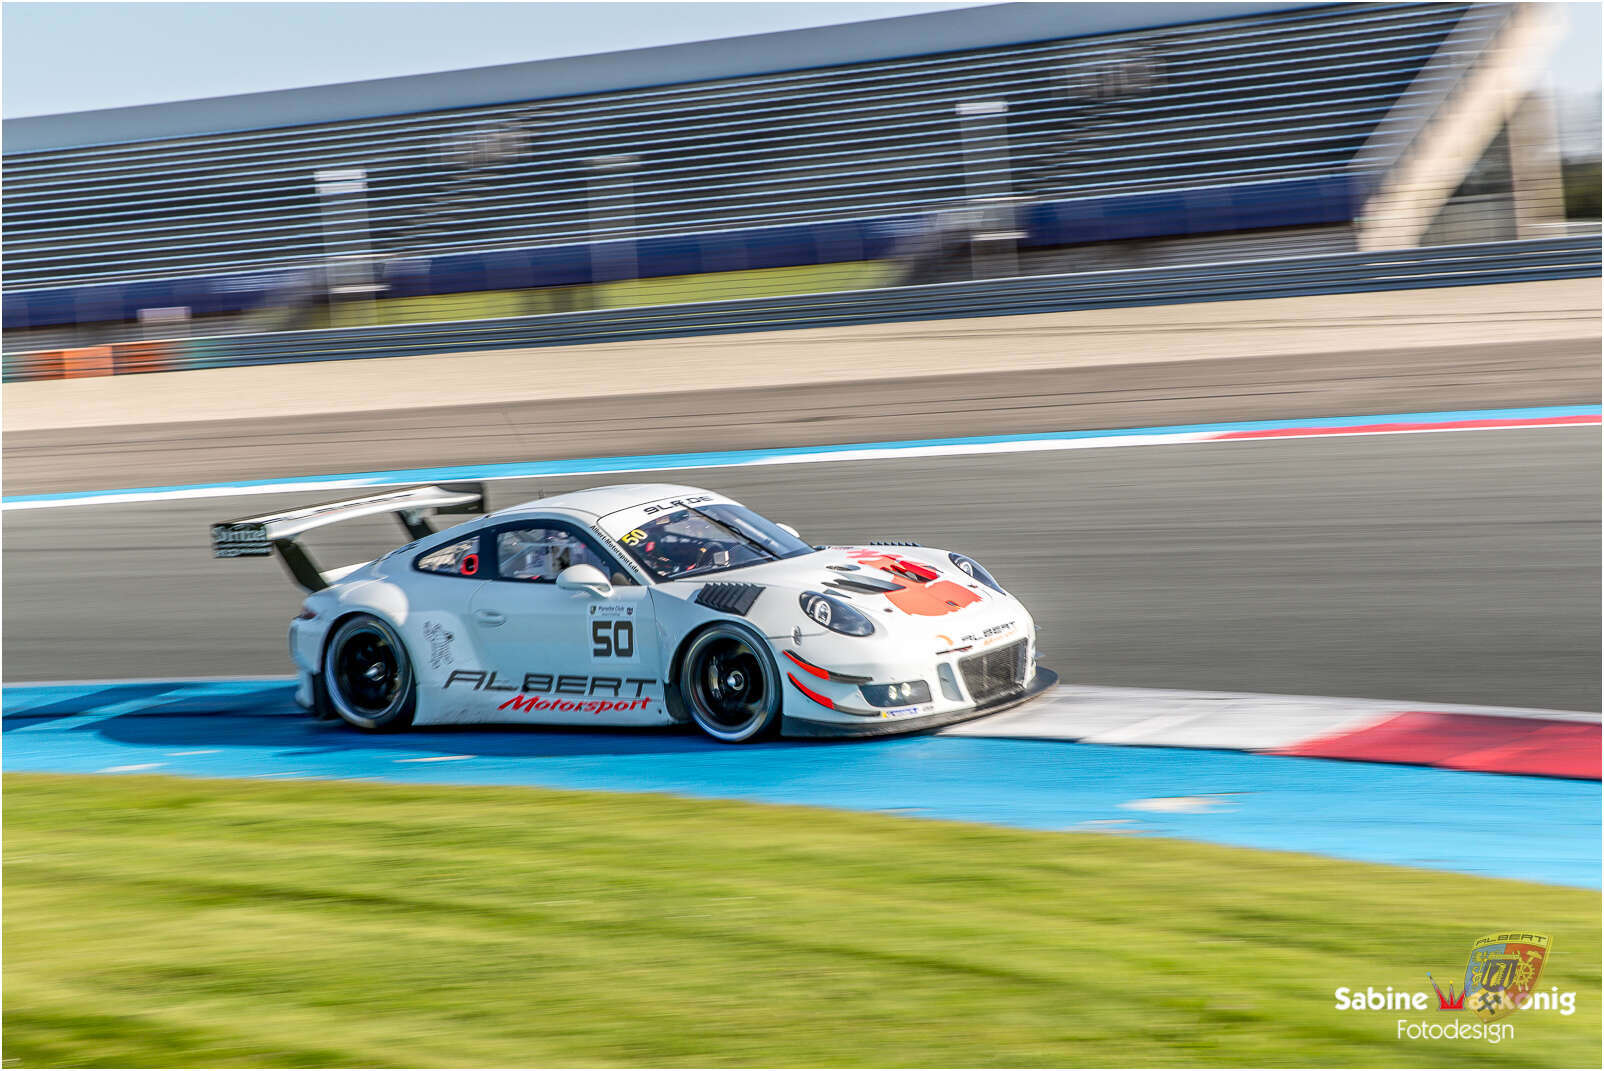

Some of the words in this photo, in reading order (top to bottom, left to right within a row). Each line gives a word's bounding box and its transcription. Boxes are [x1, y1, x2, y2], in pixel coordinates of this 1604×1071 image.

[621, 529, 648, 546] 50
[592, 620, 634, 657] 50
[442, 670, 657, 697] ALBERT
[497, 693, 653, 714] Motorsport
